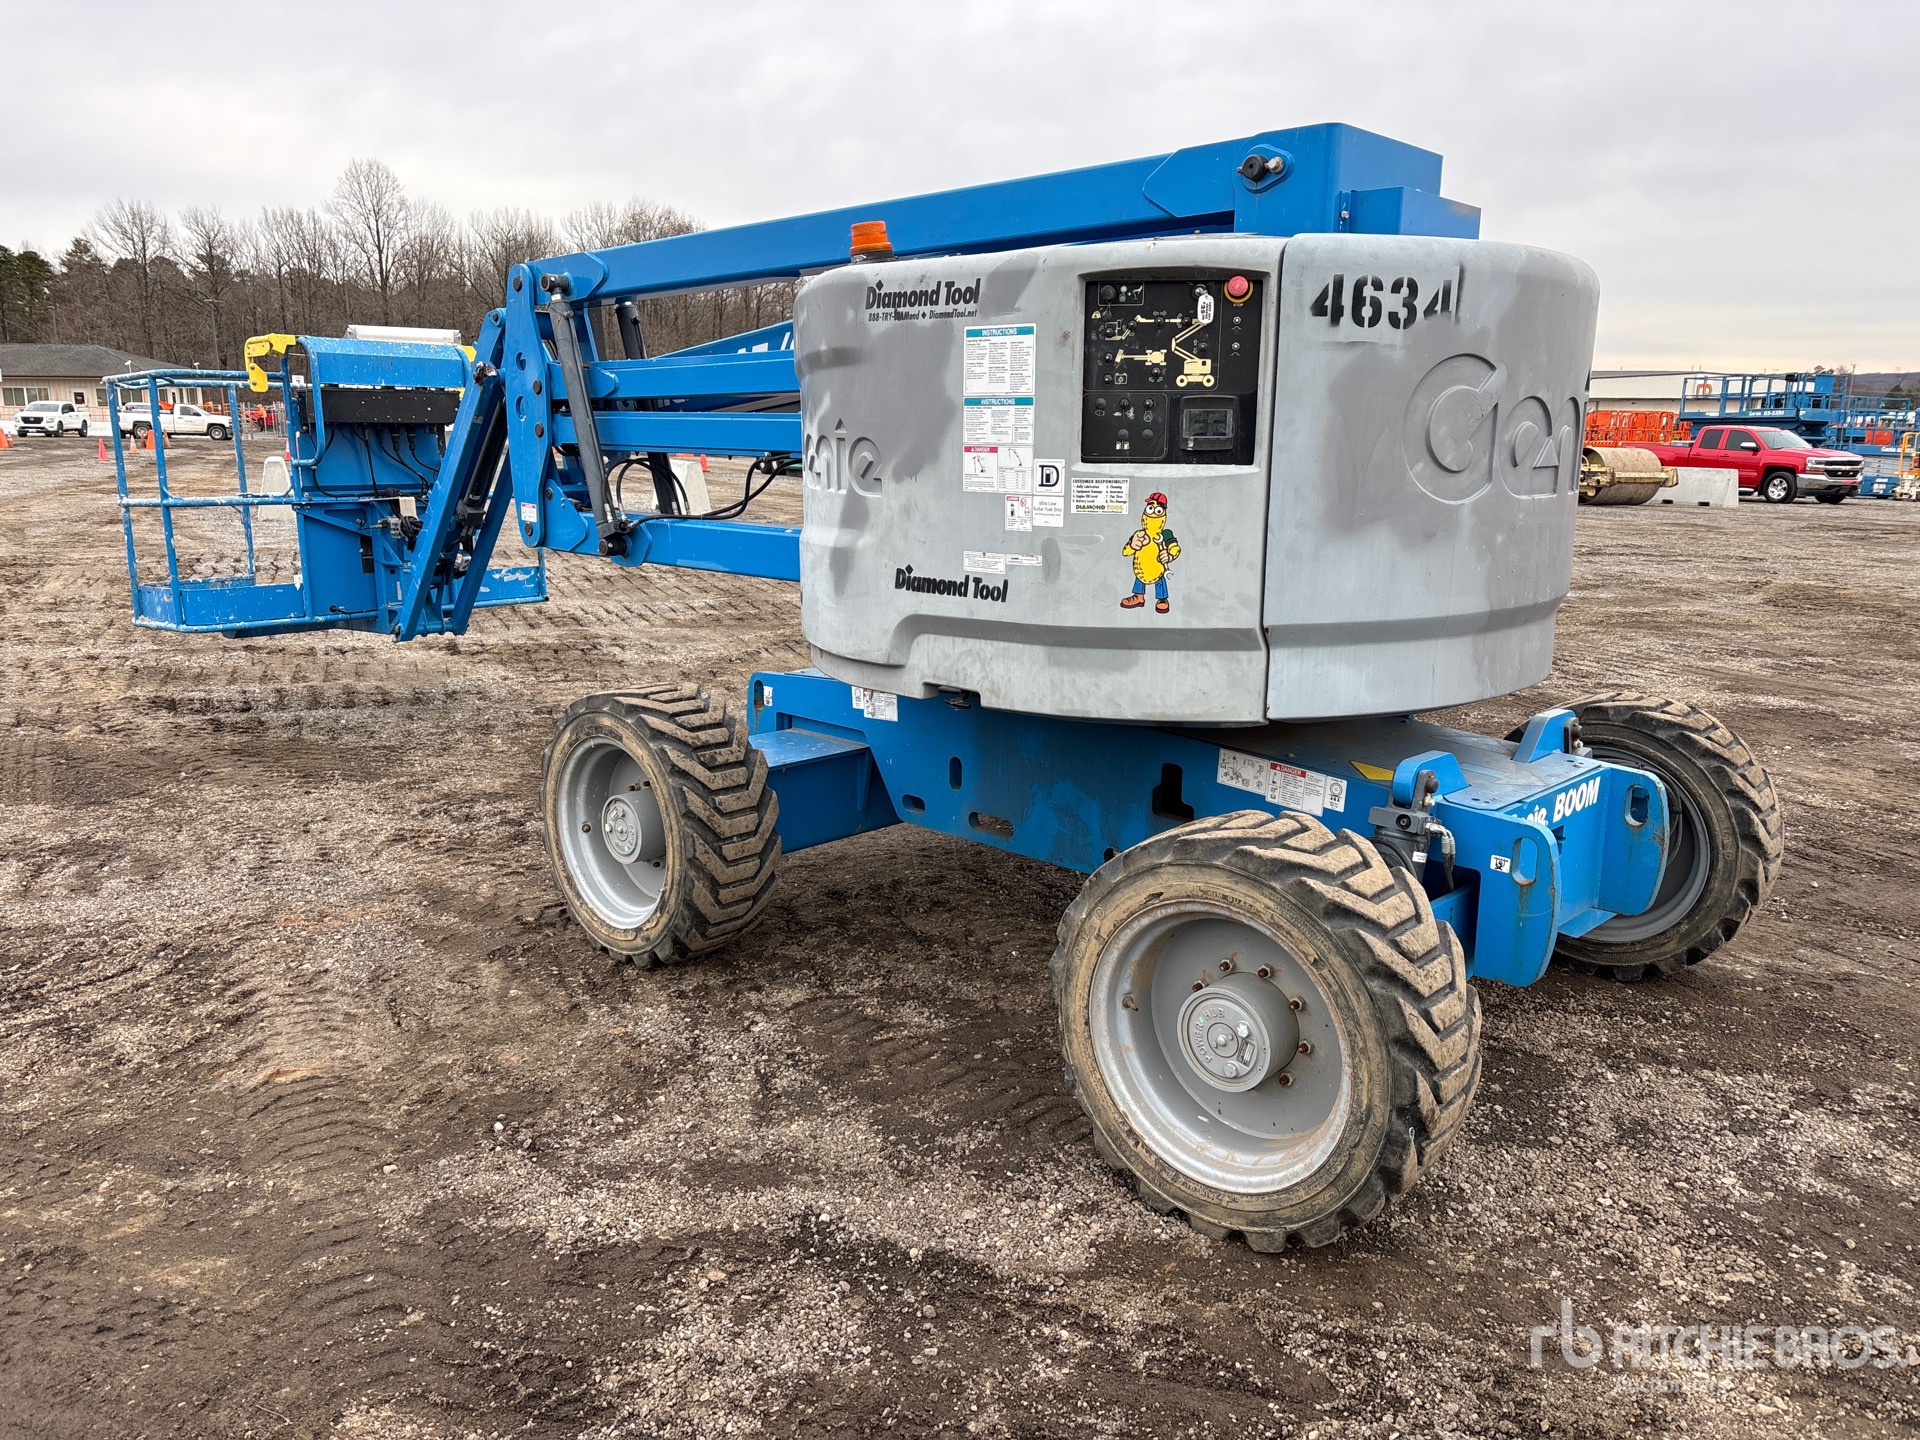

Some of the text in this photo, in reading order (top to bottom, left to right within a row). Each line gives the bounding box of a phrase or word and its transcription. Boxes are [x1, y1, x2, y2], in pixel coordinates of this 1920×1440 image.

[865, 278, 981, 310] Diamond Tool
[1310, 273, 1453, 330] 4634
[981, 328, 1018, 336] INSTRUCTIONS
[803, 417, 883, 498] enie
[1038, 465, 1060, 487] D
[894, 564, 1009, 603] Diamond Tool
[1280, 764, 1302, 777] DANGER
[1512, 776, 1601, 827] nie BOOM
[1194, 1021, 1213, 1063] POWER
